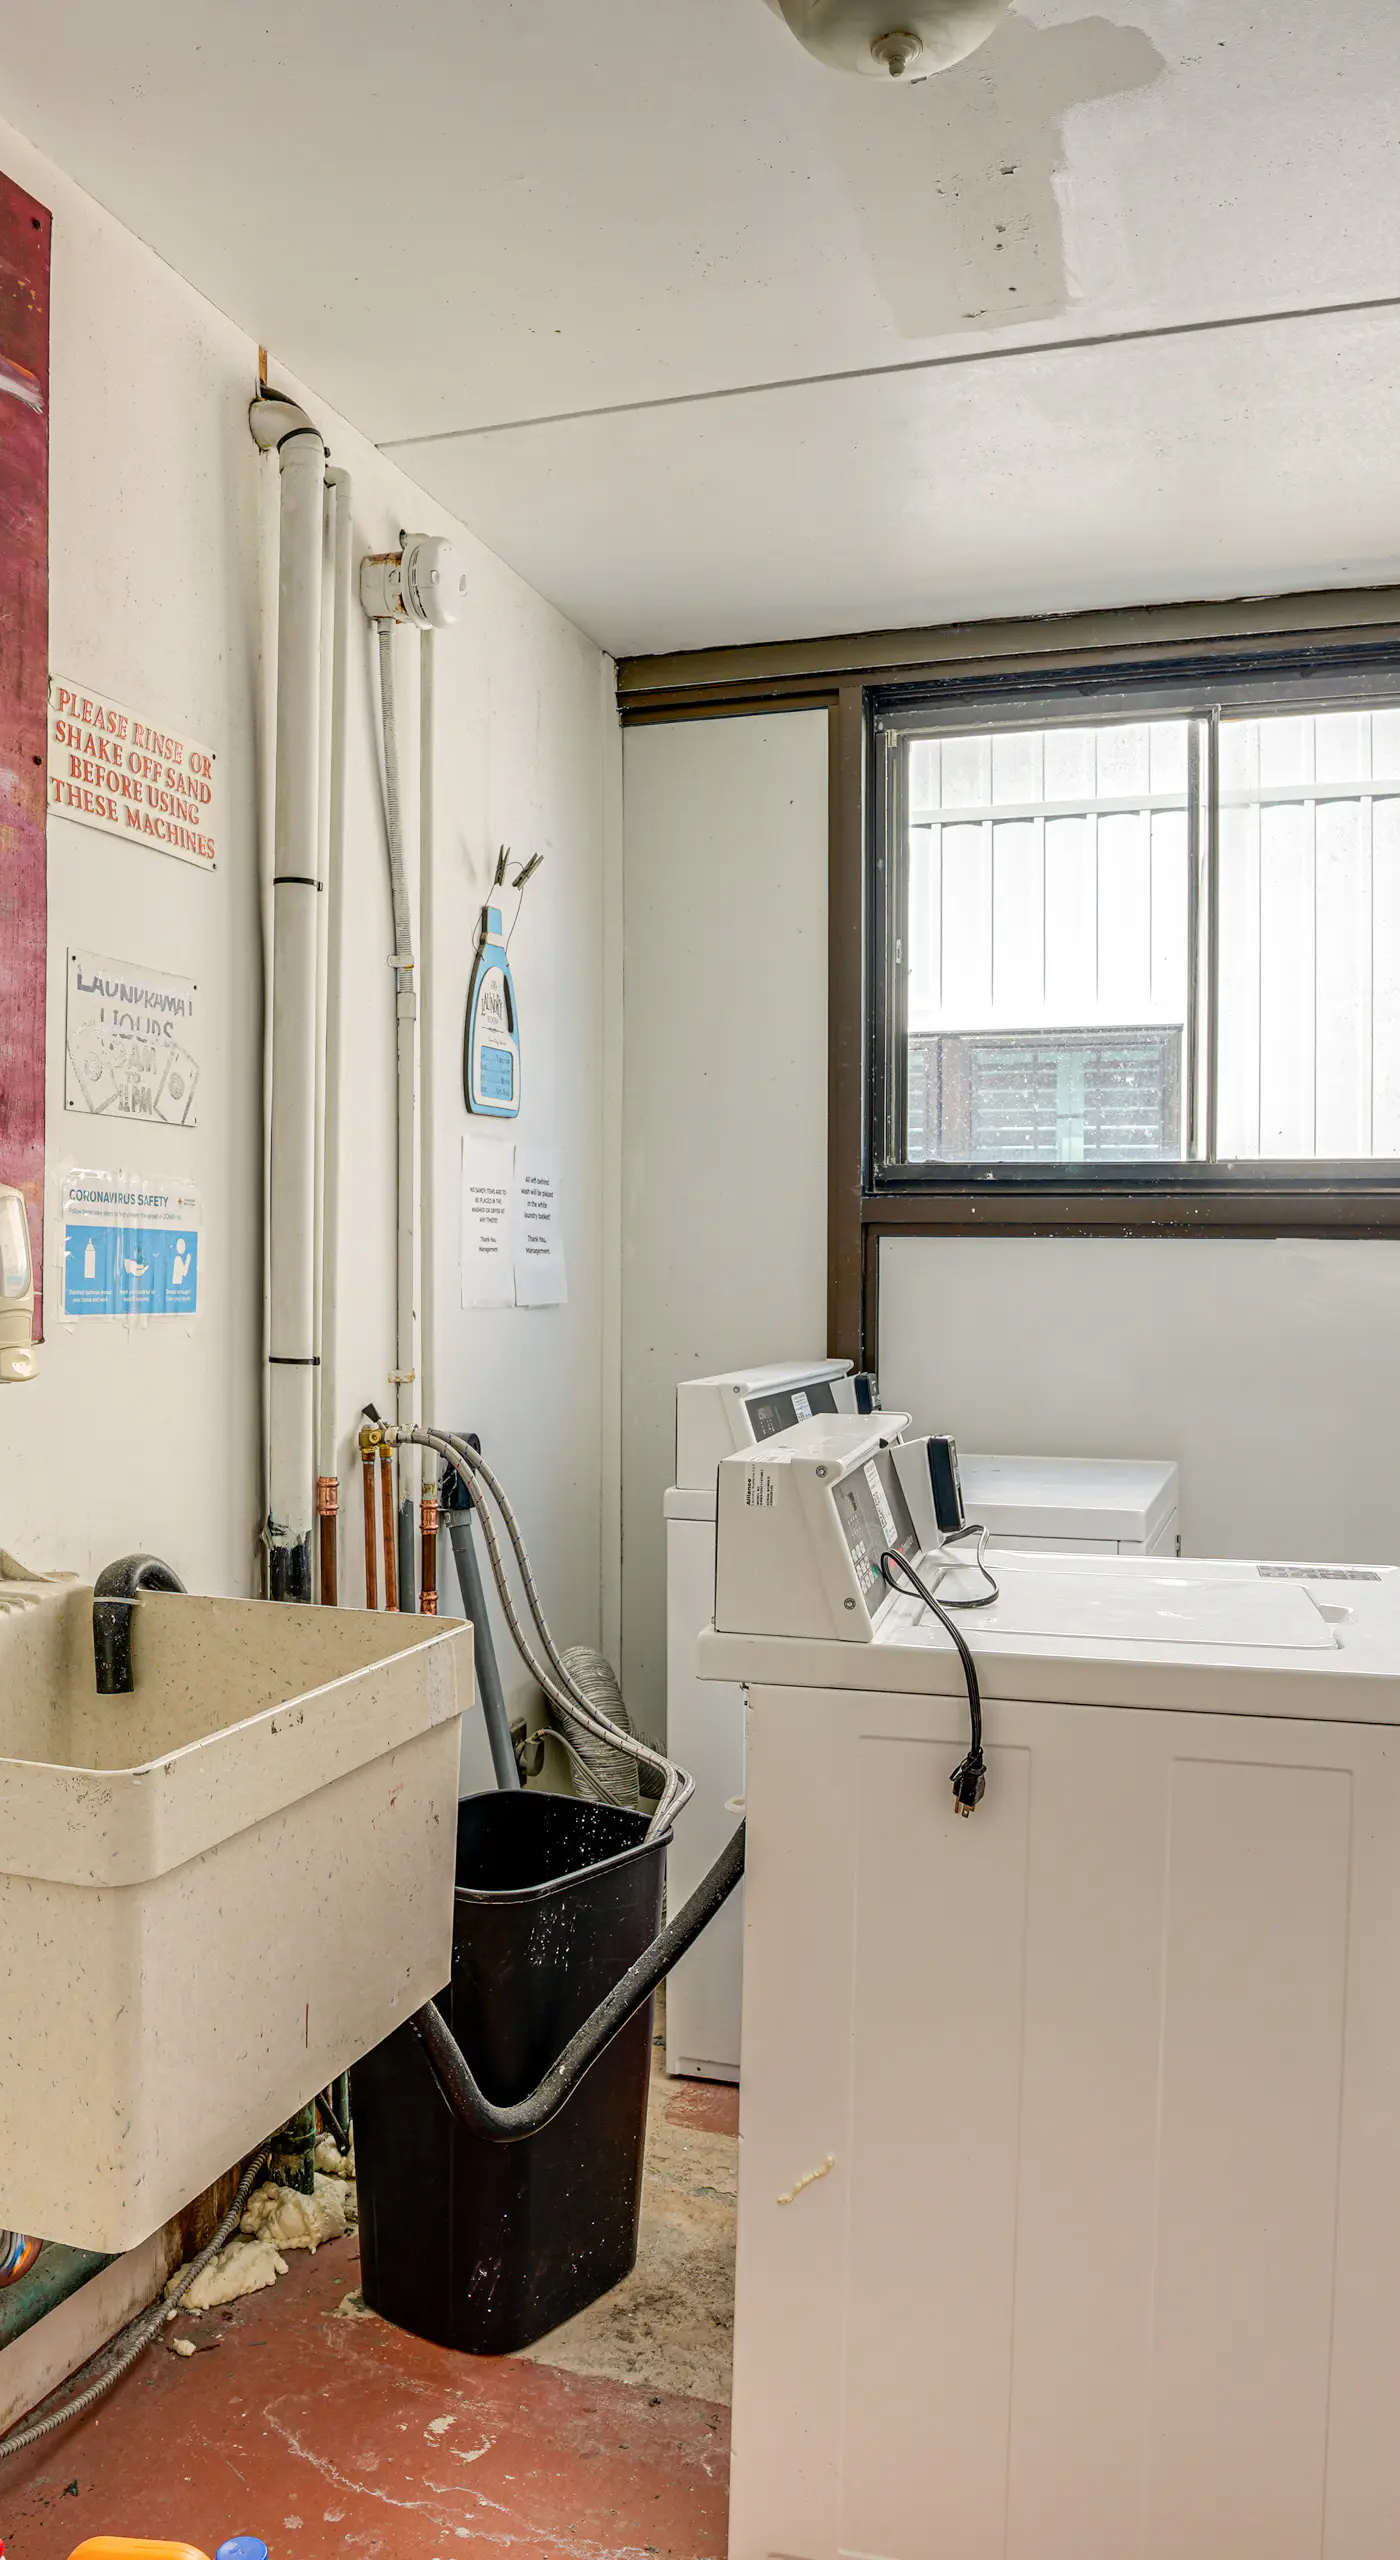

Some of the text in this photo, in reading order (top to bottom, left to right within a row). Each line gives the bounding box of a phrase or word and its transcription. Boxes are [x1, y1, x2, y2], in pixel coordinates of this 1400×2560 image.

[55, 720, 212, 804] SHAKE OFF SAND
[58, 688, 213, 780] PLEASE RINSE OR
[51, 778, 215, 860] THESE MACHINES
[70, 755, 200, 825] BEFORE USING
[69, 1189, 136, 1205] CORONAVIRUS
[137, 1194, 169, 1207] SAFETY
